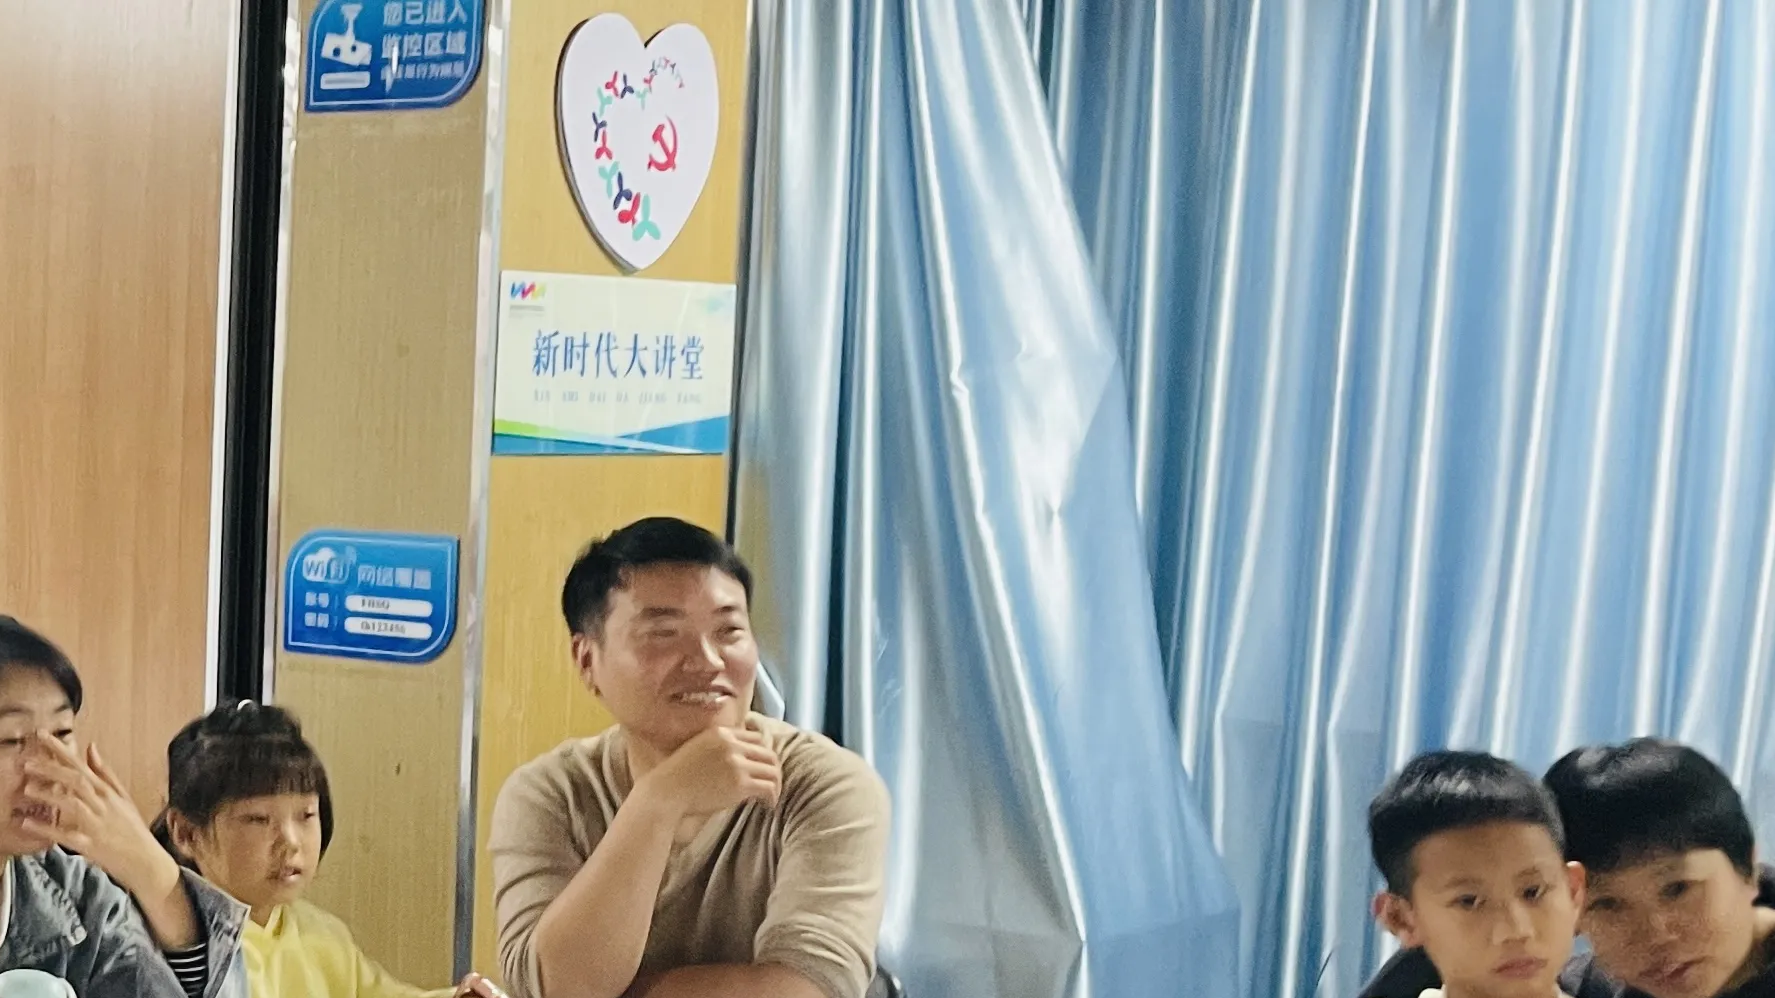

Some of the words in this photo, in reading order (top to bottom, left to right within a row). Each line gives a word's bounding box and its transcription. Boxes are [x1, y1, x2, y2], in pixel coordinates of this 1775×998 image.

[531, 329, 705, 380] 新时代大讲堂
